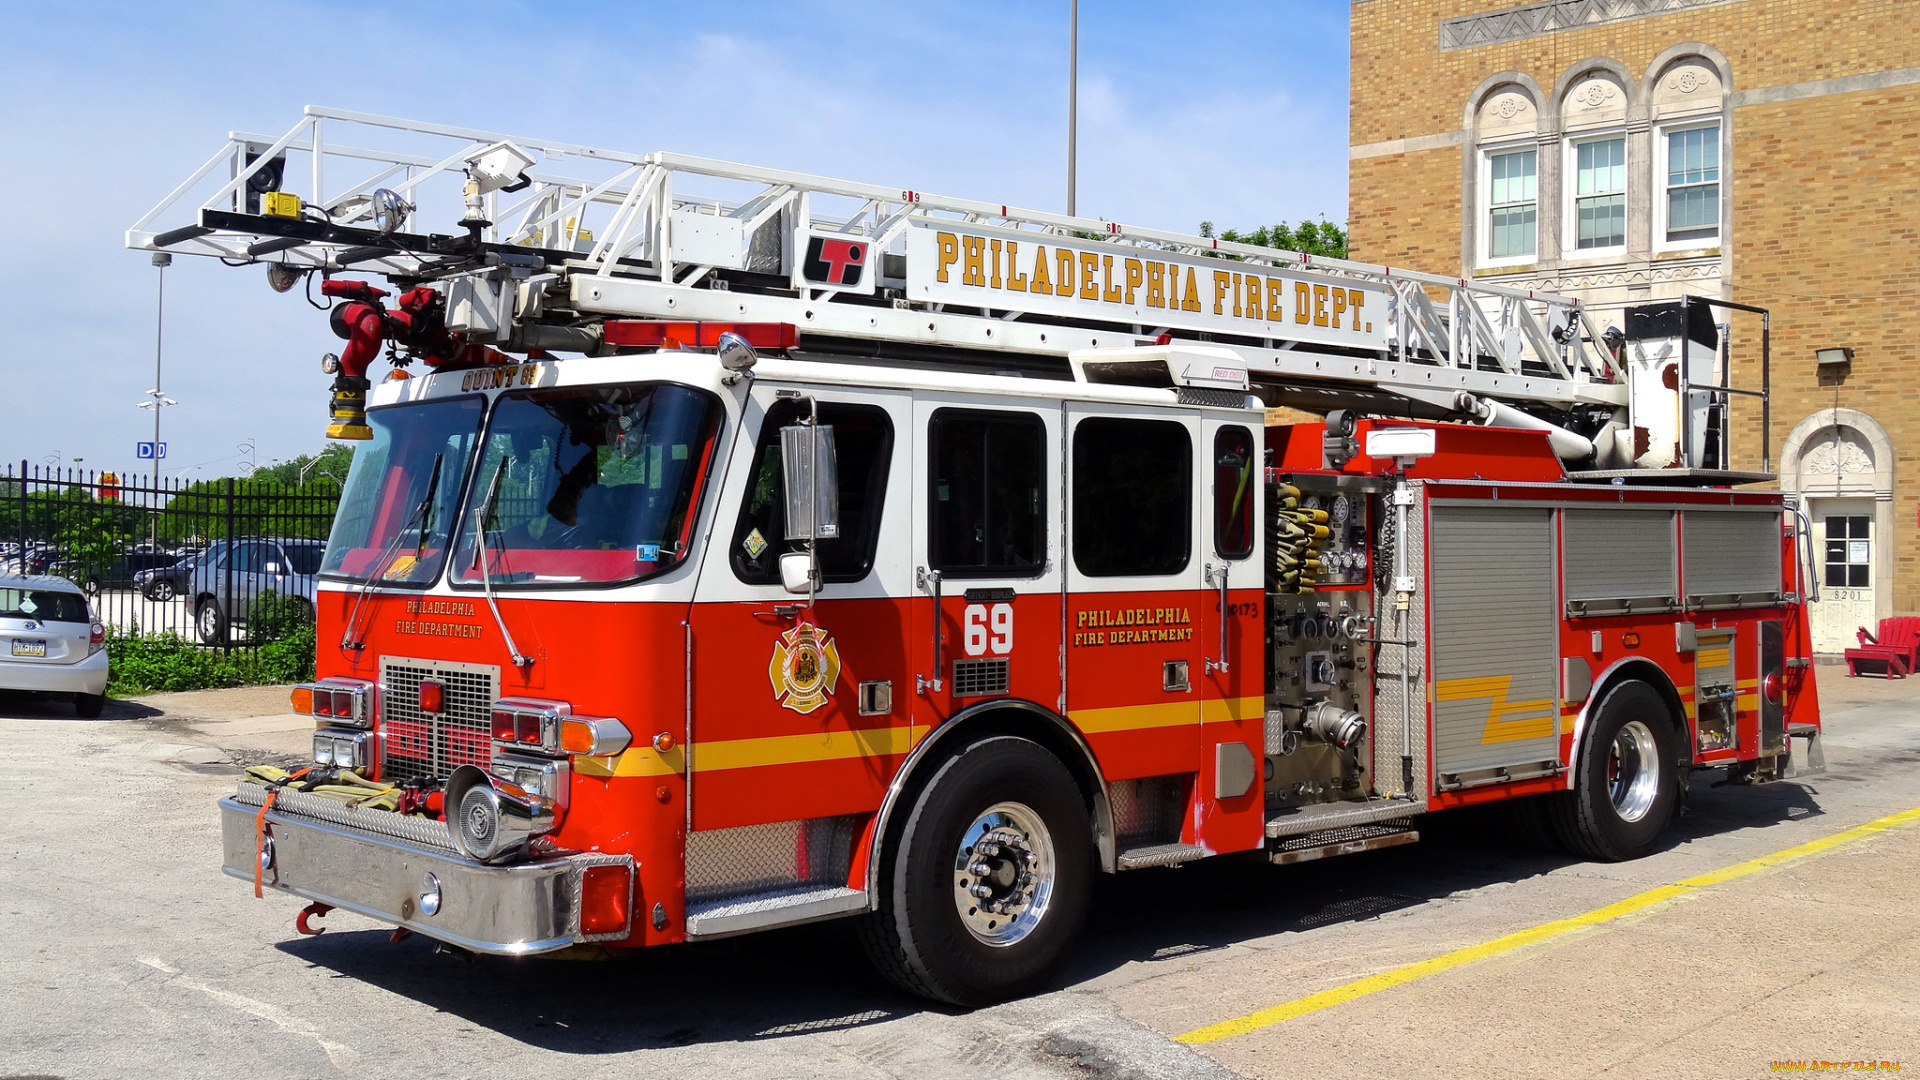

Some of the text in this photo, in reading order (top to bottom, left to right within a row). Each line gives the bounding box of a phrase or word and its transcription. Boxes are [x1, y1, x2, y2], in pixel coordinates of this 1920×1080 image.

[937, 231, 1372, 333] PHILADELPHIA FIRE DEPT.
[461, 363, 538, 393] QUINT 69
[1214, 369, 1244, 380] RED DOT
[140, 443, 152, 457] D
[158, 443, 166, 457] D
[1834, 590, 1861, 600] 8201
[406, 601, 475, 616] PHILADELPHIA
[1077, 607, 1191, 629] PHILADELPHIA
[396, 620, 482, 639] FIRE DEPARTMENT
[964, 603, 1013, 656] 69
[1074, 628, 1193, 647] FIRE DEPARTMENT
